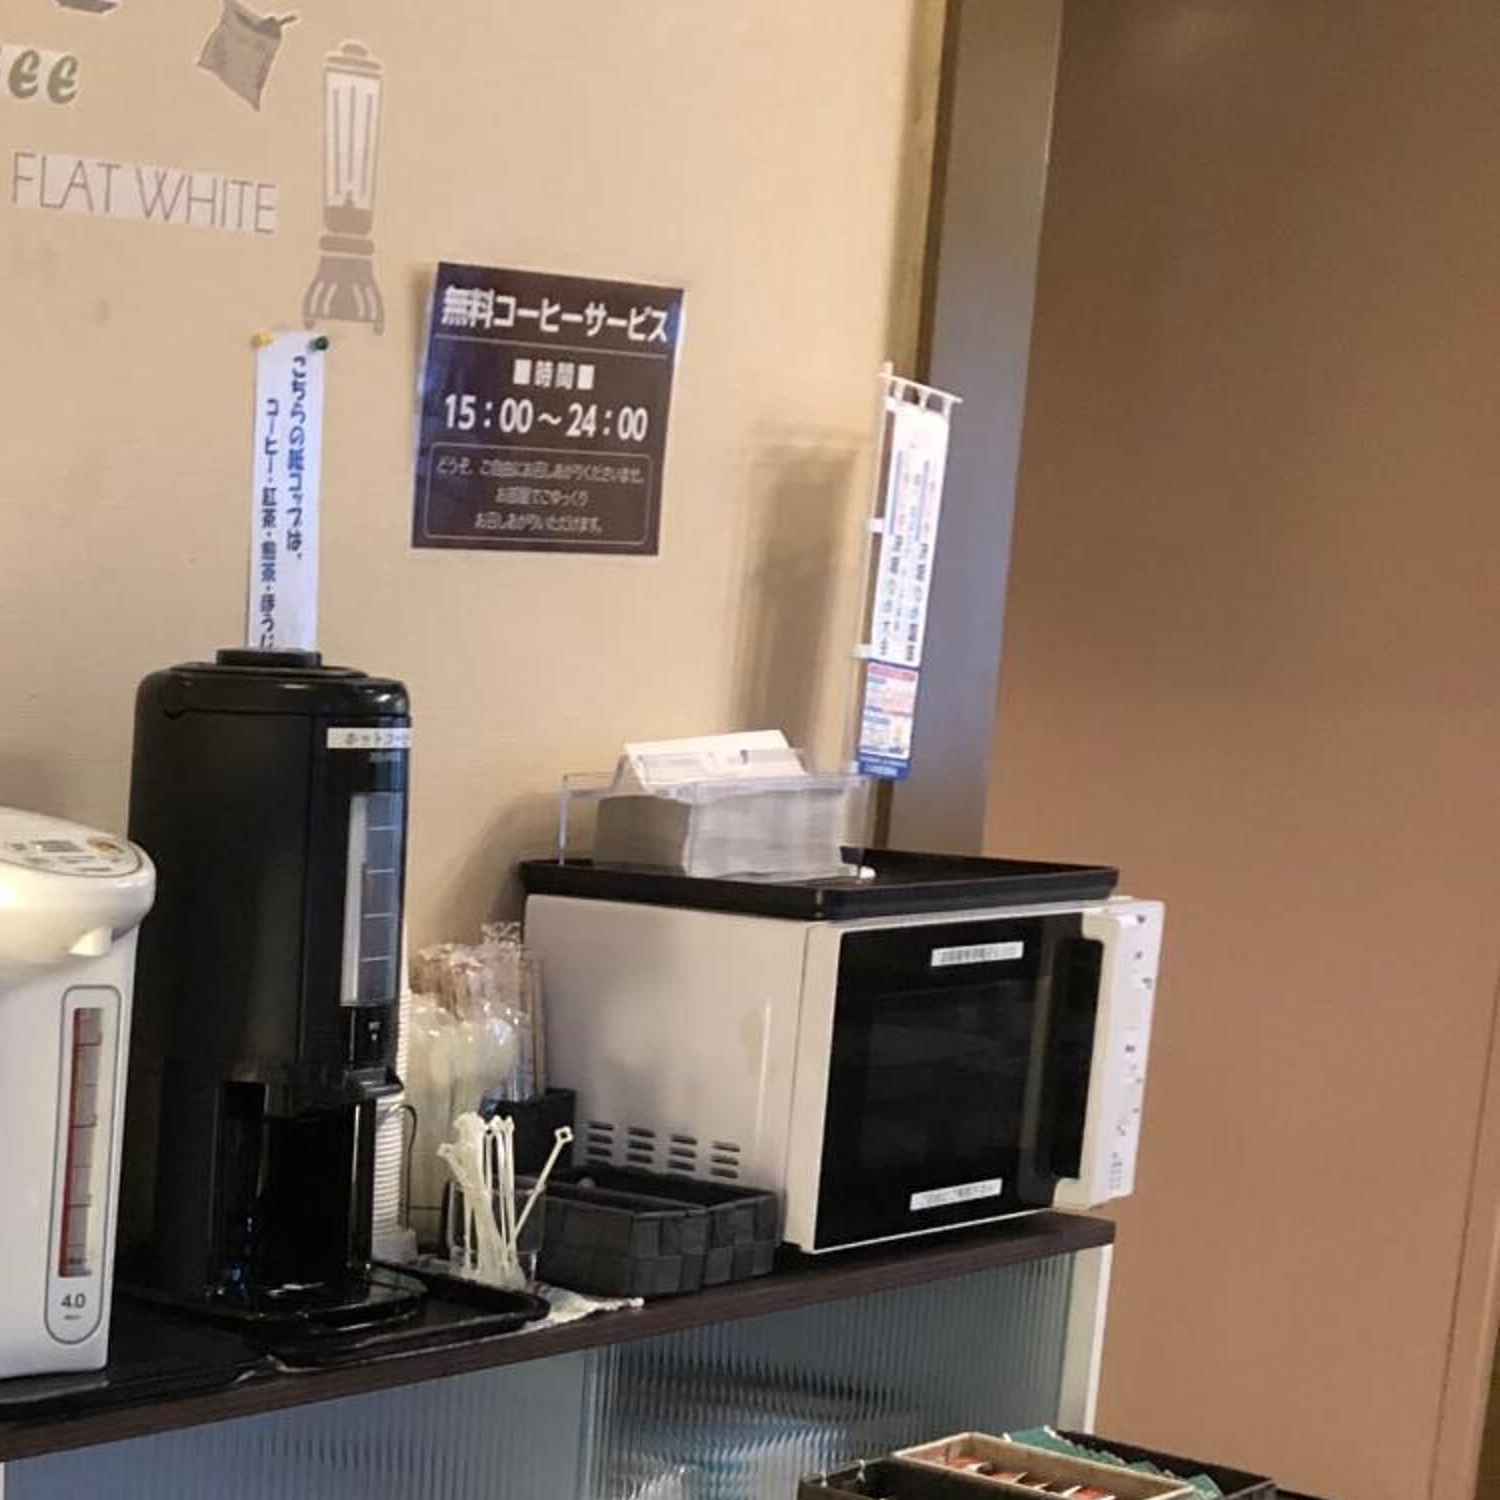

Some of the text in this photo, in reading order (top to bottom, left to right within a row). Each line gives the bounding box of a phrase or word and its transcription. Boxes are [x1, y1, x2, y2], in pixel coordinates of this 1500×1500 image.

[12, 151, 276, 234] FLAT WHITE
[440, 285, 668, 343] 無料コーヒーサービス
